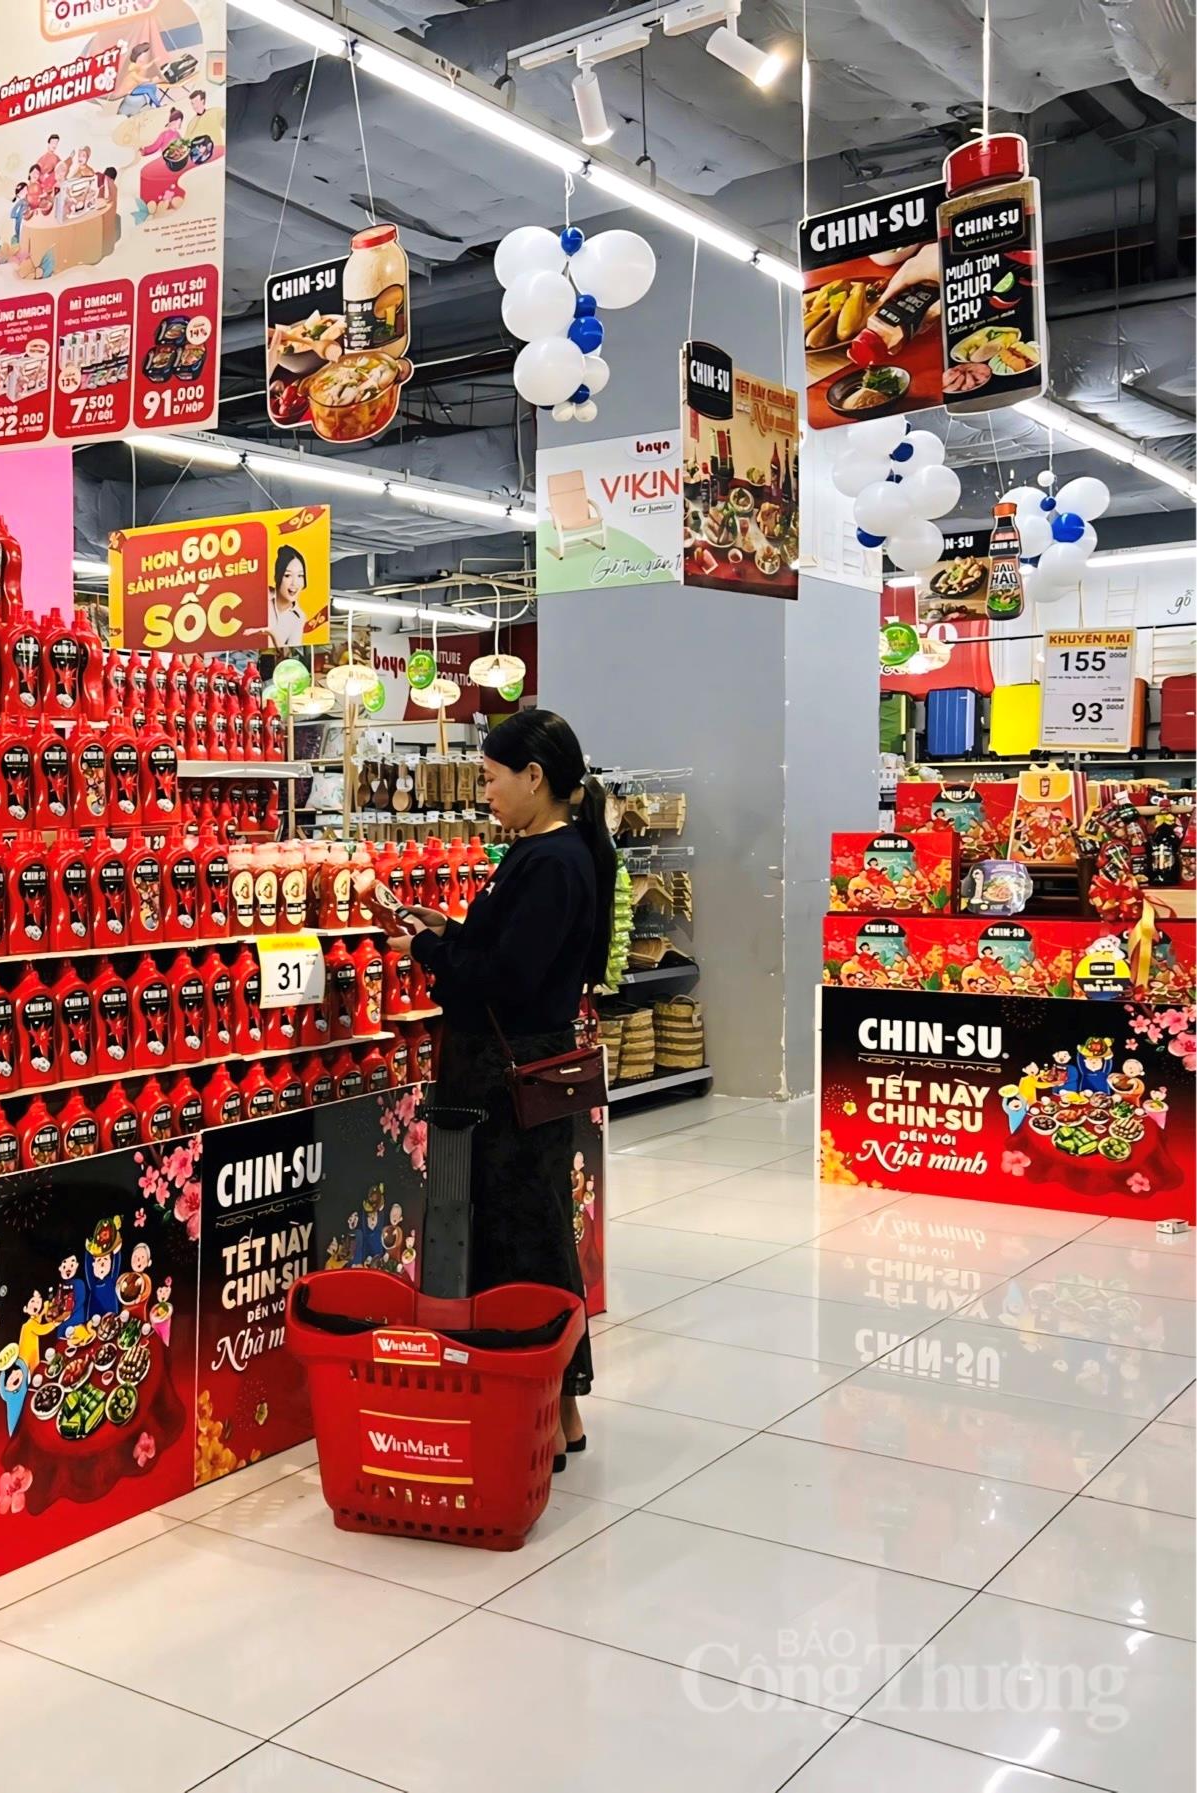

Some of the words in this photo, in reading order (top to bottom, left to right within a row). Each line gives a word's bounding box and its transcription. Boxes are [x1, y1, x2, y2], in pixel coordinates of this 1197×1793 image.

[60, 56, 92, 80] NGÀY
[95, 46, 120, 68] TẾT
[8, 103, 21, 118] LÀ
[24, 76, 92, 113] OMACHI
[810, 198, 925, 252] CHIN-SU
[954, 208, 1019, 238] CHIN-SU
[946, 258, 973, 282] MUỐI
[975, 253, 1000, 273] TÔM
[189, 276, 207, 291] SÔI
[272, 268, 336, 301] CHIN-SU
[947, 272, 991, 304] CHUA
[16, 304, 52, 320] OMACHI
[69, 295, 82, 311] MÌ
[84, 292, 123, 308] OMACHI
[151, 292, 204, 314] OMACHI
[947, 298, 982, 326] CAY
[60, 376, 78, 387] 13%
[690, 359, 730, 393] CHIN-SU
[600, 468, 679, 504] VIKIN
[141, 551, 178, 573] HƠN
[181, 528, 242, 564] 600
[127, 575, 154, 595] SẢN
[156, 566, 196, 590] PHẨM
[198, 562, 223, 584] GIÁ
[225, 558, 259, 576] SIÊU
[142, 583, 243, 649] SỐC
[1049, 632, 1102, 644] KHUYẾN
[373, 648, 406, 678] baya
[1060, 651, 1106, 672] 155
[1072, 702, 1103, 723] 93
[873, 839, 908, 849] CHIN-SU
[864, 924, 900, 934] CHIN-SU
[988, 927, 1024, 938] CHIN-SU
[278, 962, 301, 991] 31
[858, 1017, 1002, 1059] CHIN-SU
[858, 1056, 905, 1065] NGON
[866, 1071, 922, 1102] TẾT
[929, 1078, 990, 1108] NÀY
[867, 1102, 983, 1133] CHIN-SU
[899, 1129, 928, 1142] ĐẾN
[932, 1133, 956, 1146] VỚI
[855, 1139, 923, 1173] Nhà
[927, 1149, 988, 1175] mình
[216, 1141, 323, 1208] CHIN-SU
[222, 1227, 266, 1276] TẾT
[270, 1220, 314, 1261] NÀY
[222, 1257, 308, 1310] CHIN-SU
[247, 1302, 269, 1324] ĐẾN
[271, 1296, 286, 1314] VỚ
[211, 1326, 265, 1372] Nhà
[377, 1338, 428, 1353] WinMart
[367, 1430, 451, 1457] WinMart
